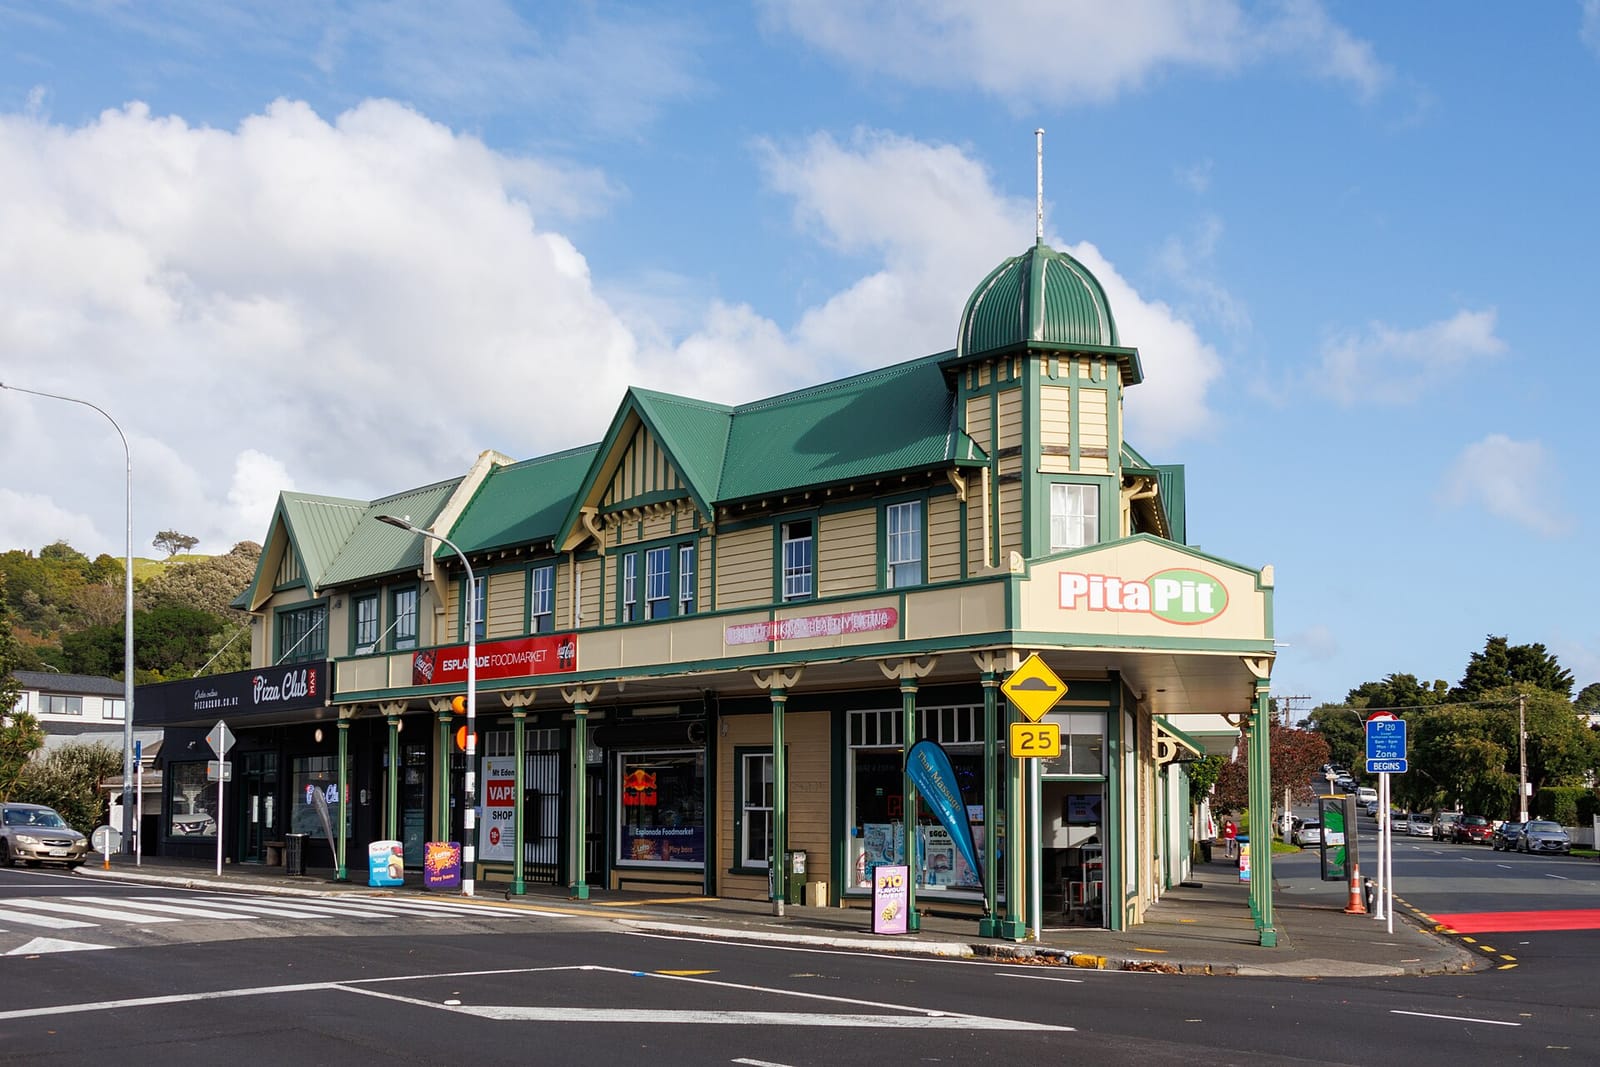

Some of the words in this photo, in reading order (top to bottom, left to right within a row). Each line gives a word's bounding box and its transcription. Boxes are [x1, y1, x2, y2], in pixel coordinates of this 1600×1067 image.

[1059, 572, 1150, 612] Pita
[1154, 578, 1215, 613] Pit
[442, 655, 490, 671] ESPLAADE
[490, 649, 547, 667] FOODMARKET
[253, 675, 280, 704] Pizza
[281, 669, 308, 700] Club
[1020, 731, 1052, 750] 25
[1375, 750, 1397, 758] Zone
[492, 768, 500, 776] Mt
[500, 768, 515, 776] Eden
[1373, 762, 1400, 771] BEGINS
[489, 786, 516, 801] VAPE
[931, 770, 961, 812] Massage
[492, 810, 513, 820] SHOP
[635, 828, 661, 837] Esplanade
[661, 827, 694, 836] Foodmarket
[442, 873, 455, 881] here
